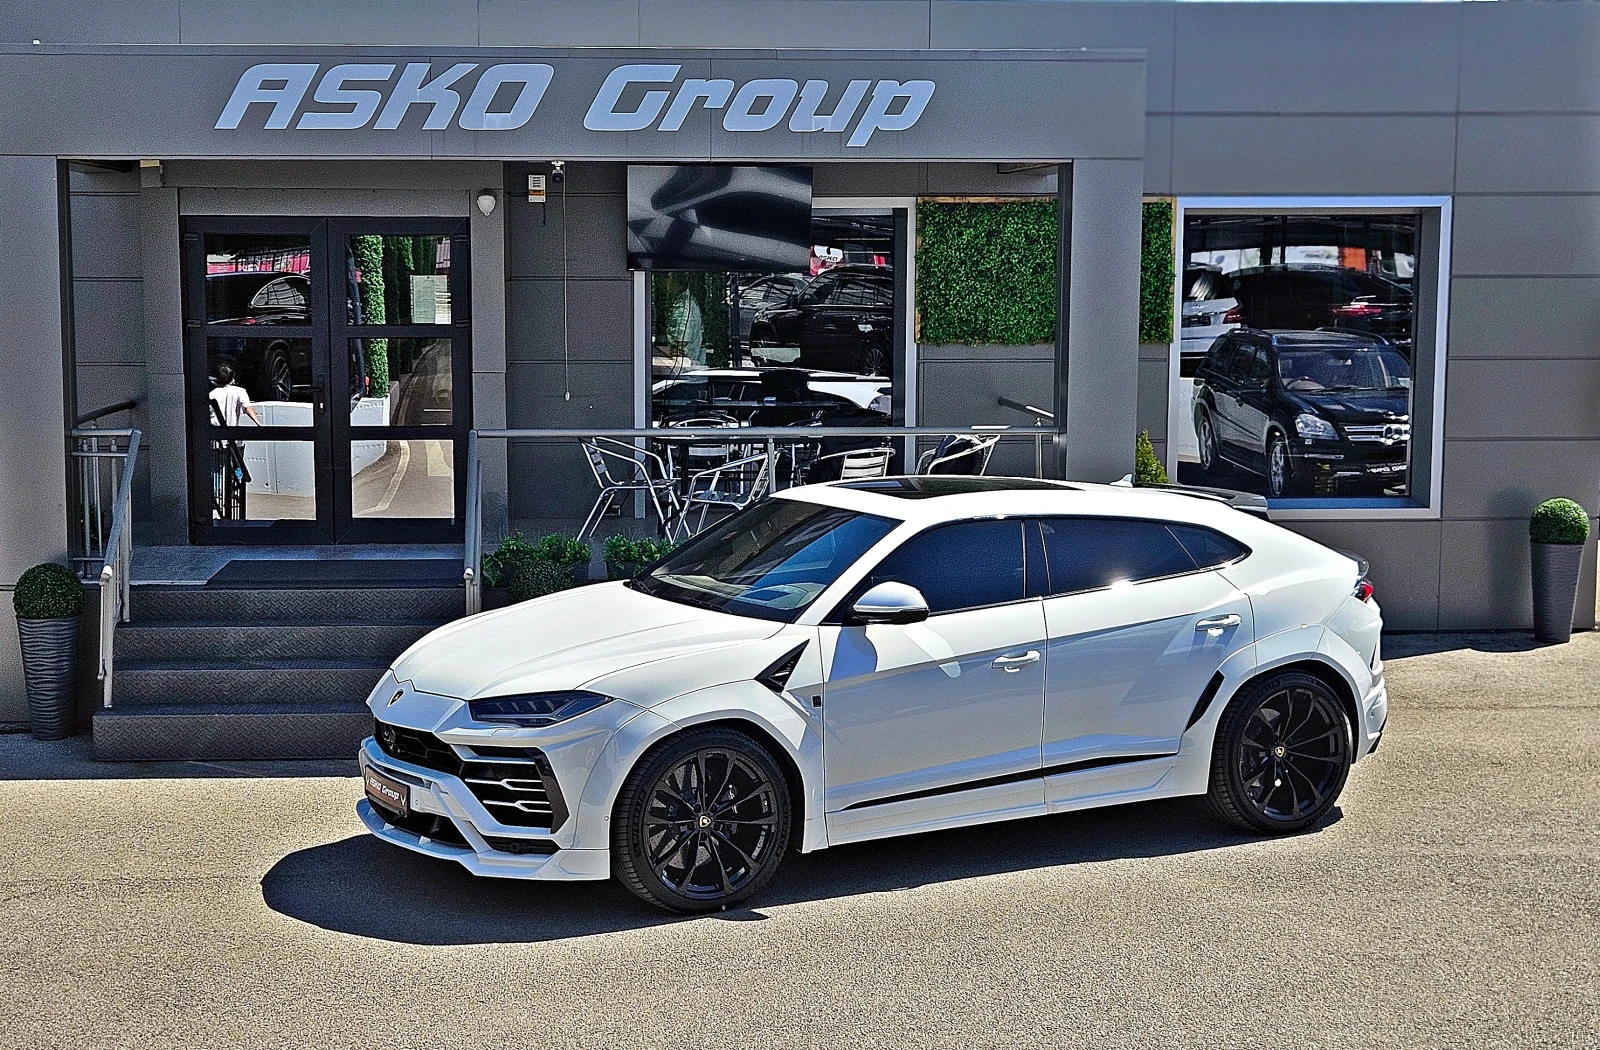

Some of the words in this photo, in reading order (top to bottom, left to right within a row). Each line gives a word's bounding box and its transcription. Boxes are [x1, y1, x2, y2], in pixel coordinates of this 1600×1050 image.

[213, 62, 555, 131] ASKO
[583, 63, 936, 148] Group
[382, 785, 400, 801] Group
